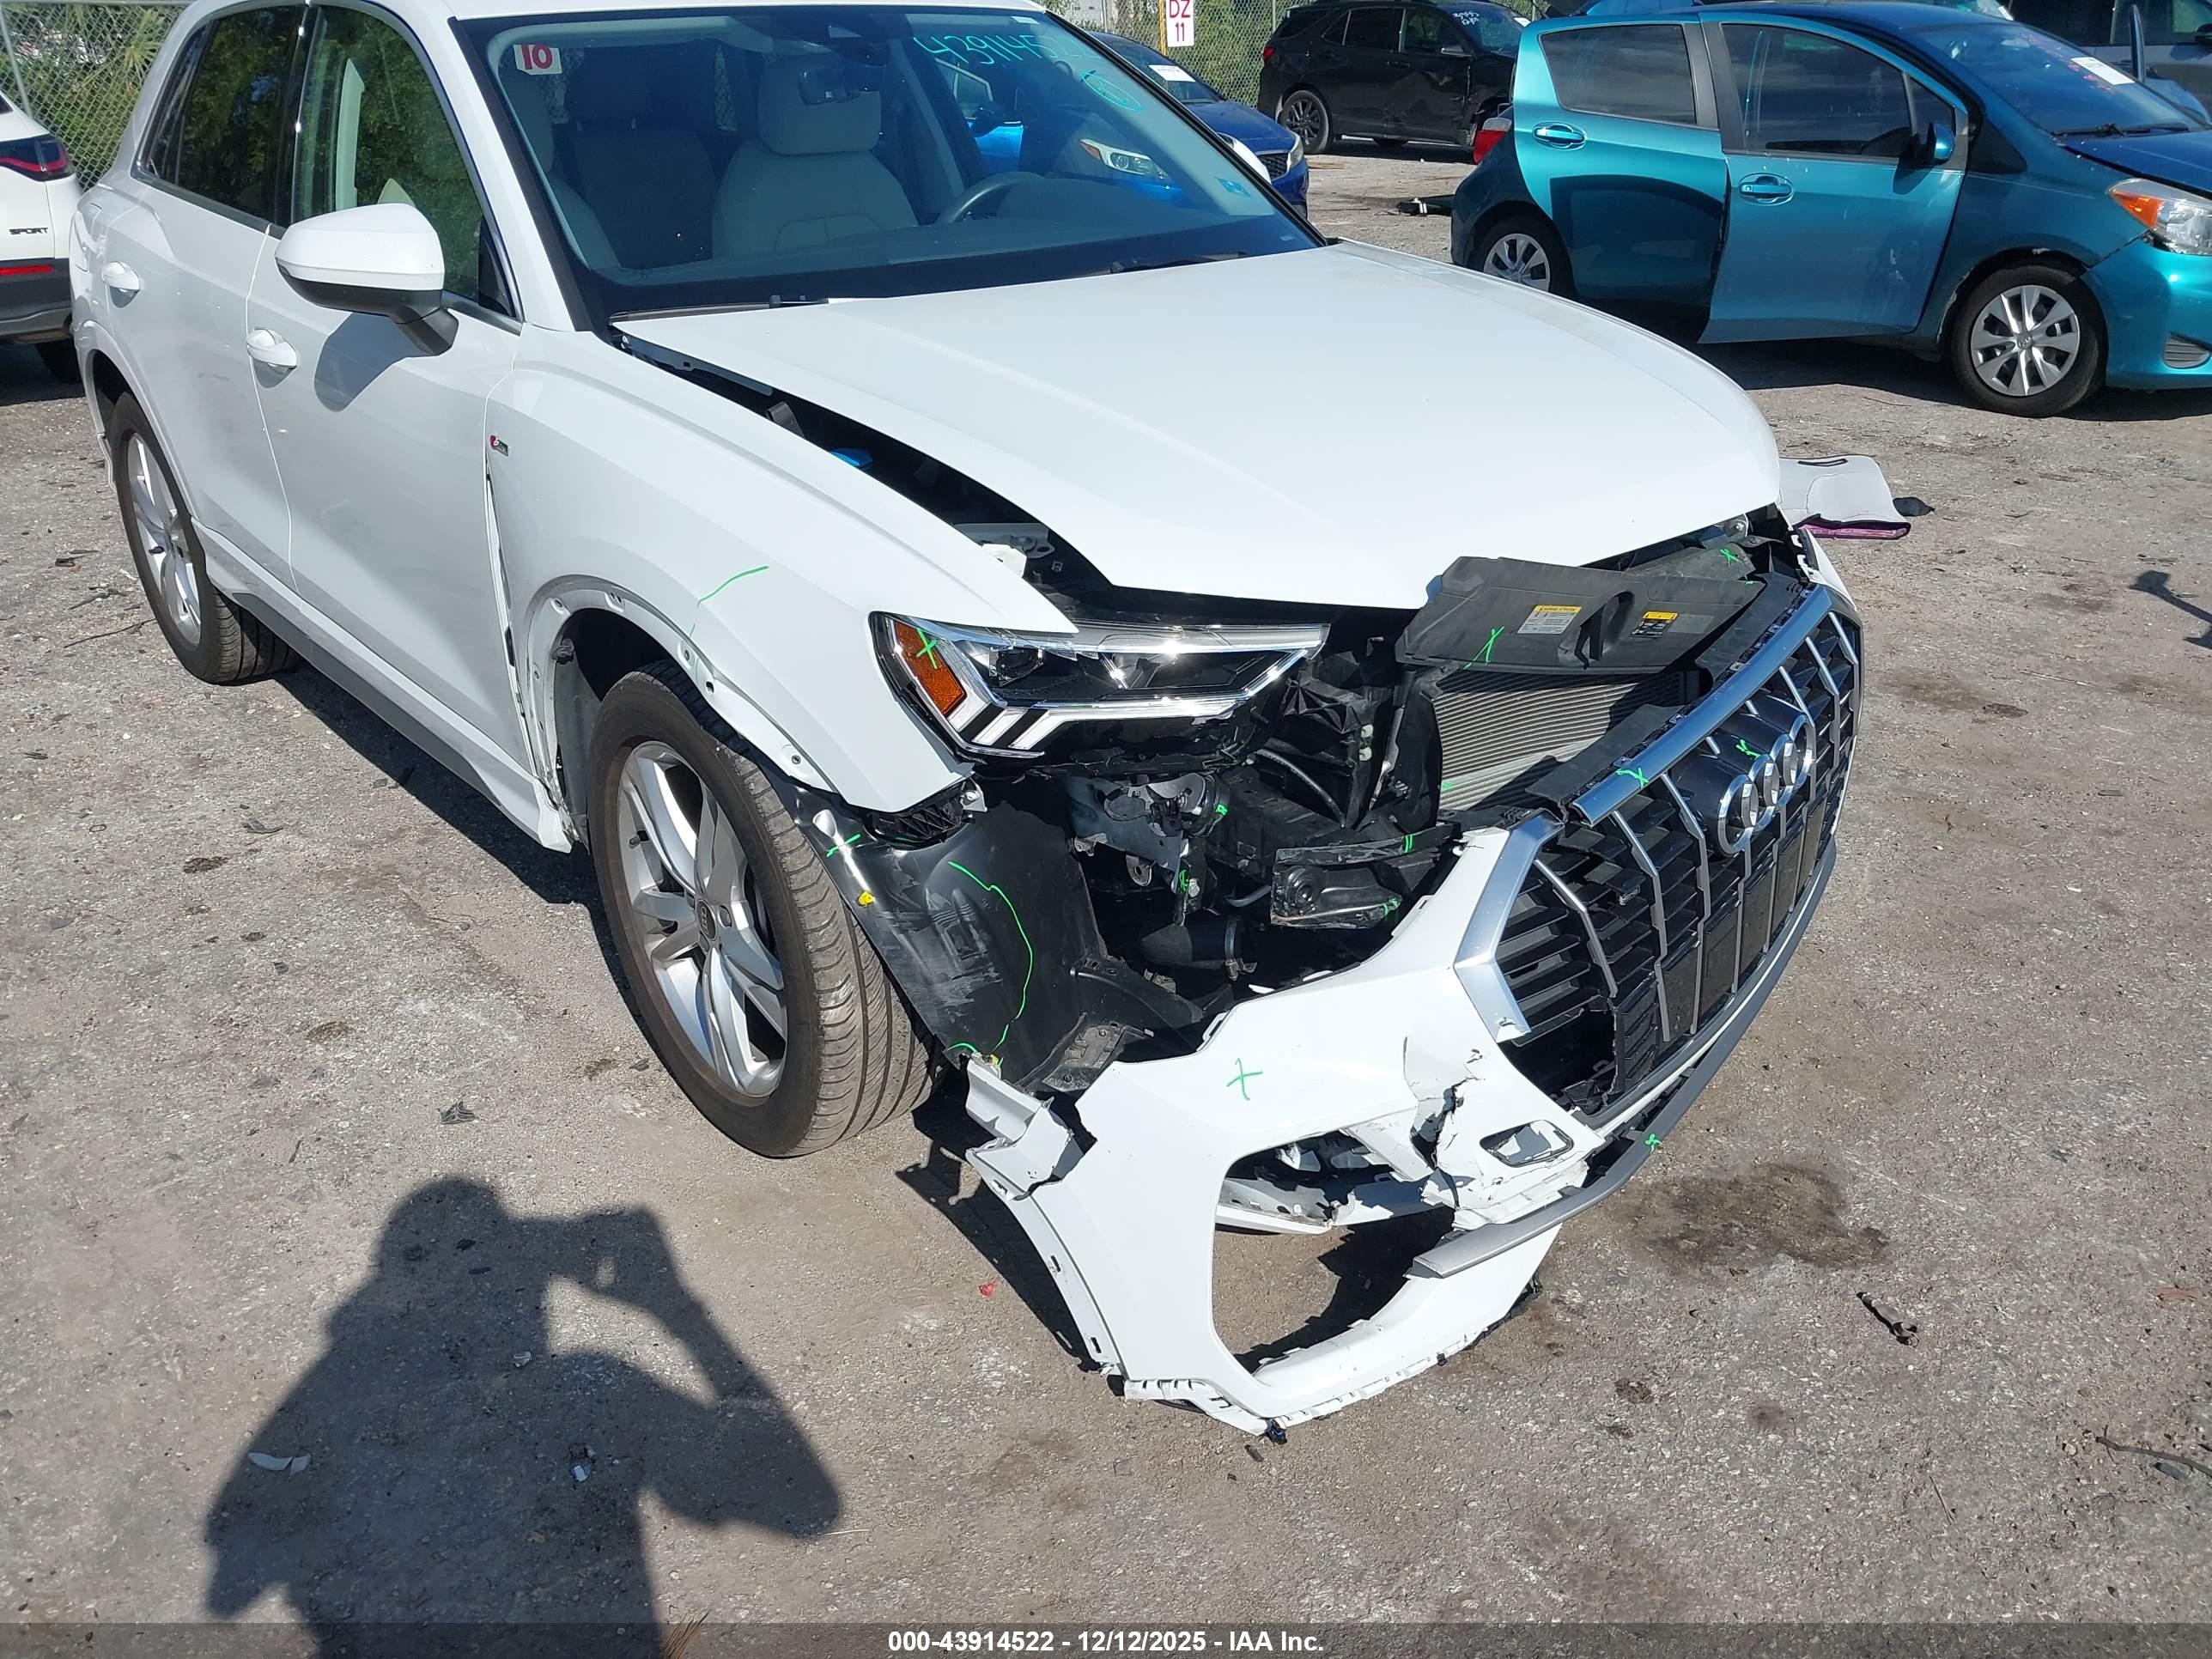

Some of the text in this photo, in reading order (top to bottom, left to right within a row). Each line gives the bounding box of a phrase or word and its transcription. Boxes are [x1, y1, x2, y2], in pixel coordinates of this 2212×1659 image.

[1169, 0, 1191, 18] DZ
[1175, 21, 1185, 42] 11
[521, 41, 553, 70] 10
[9, 227, 49, 235] SPORT
